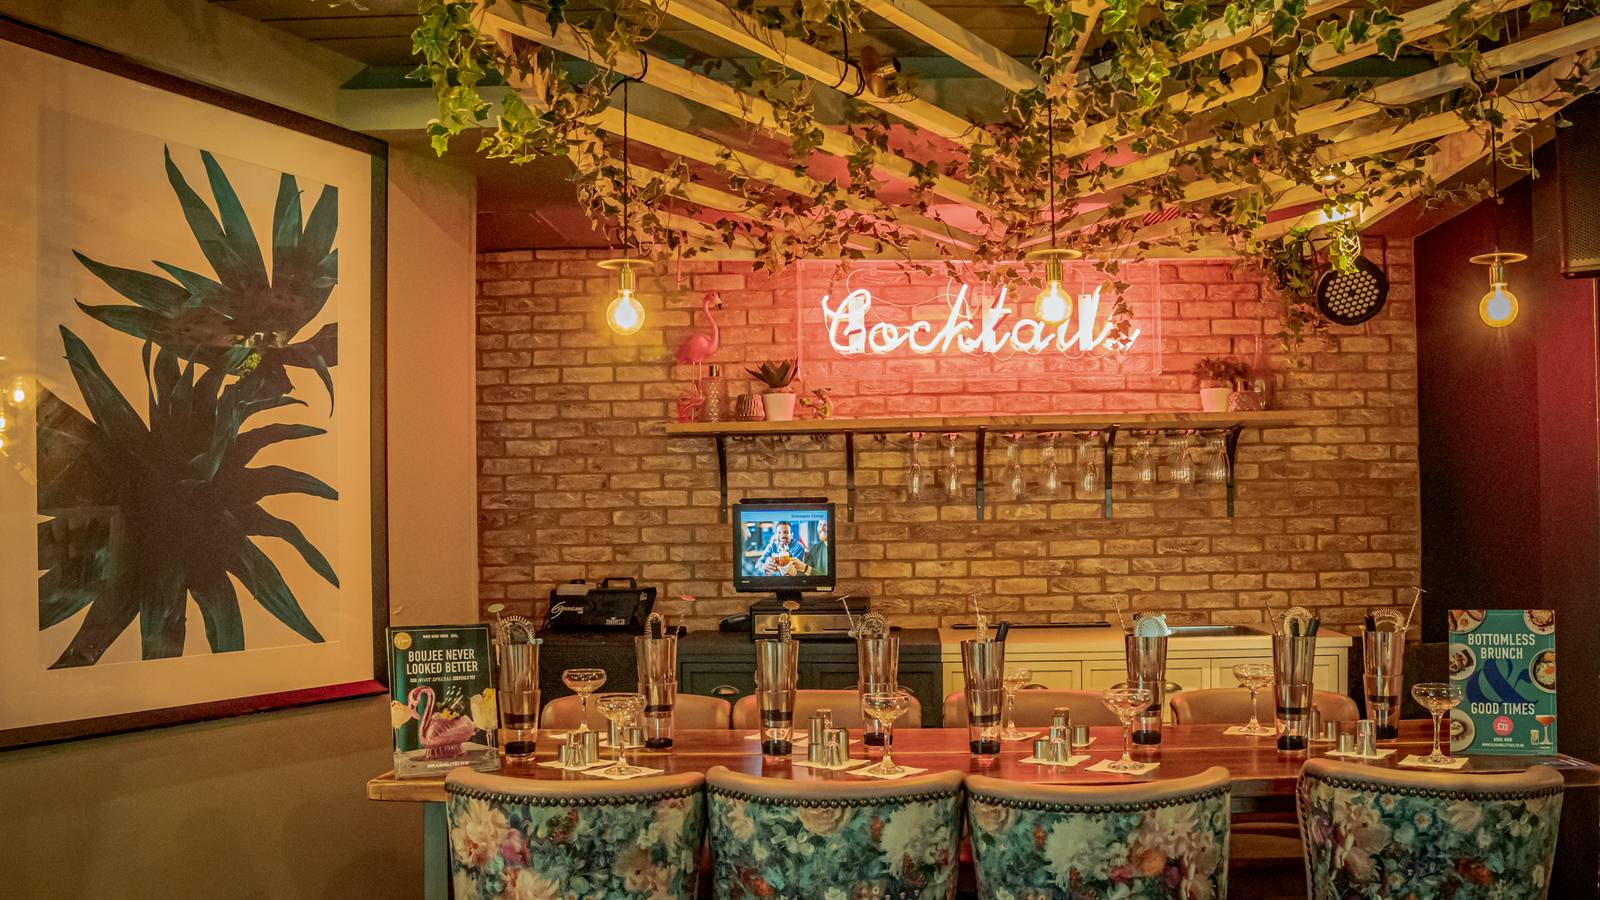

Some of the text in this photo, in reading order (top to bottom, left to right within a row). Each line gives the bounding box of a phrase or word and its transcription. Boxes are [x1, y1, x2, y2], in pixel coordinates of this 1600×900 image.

[822, 283, 1141, 354] Cocktails
[1467, 633, 1536, 646] BOTTOMLESS
[408, 649, 475, 662] BOUJEE NEVER
[1480, 647, 1523, 660] BRUNCH
[406, 661, 479, 675] LOOKED BETTER
[1465, 658, 1539, 705] &
[1470, 702, 1536, 716] GOOD TIMES
